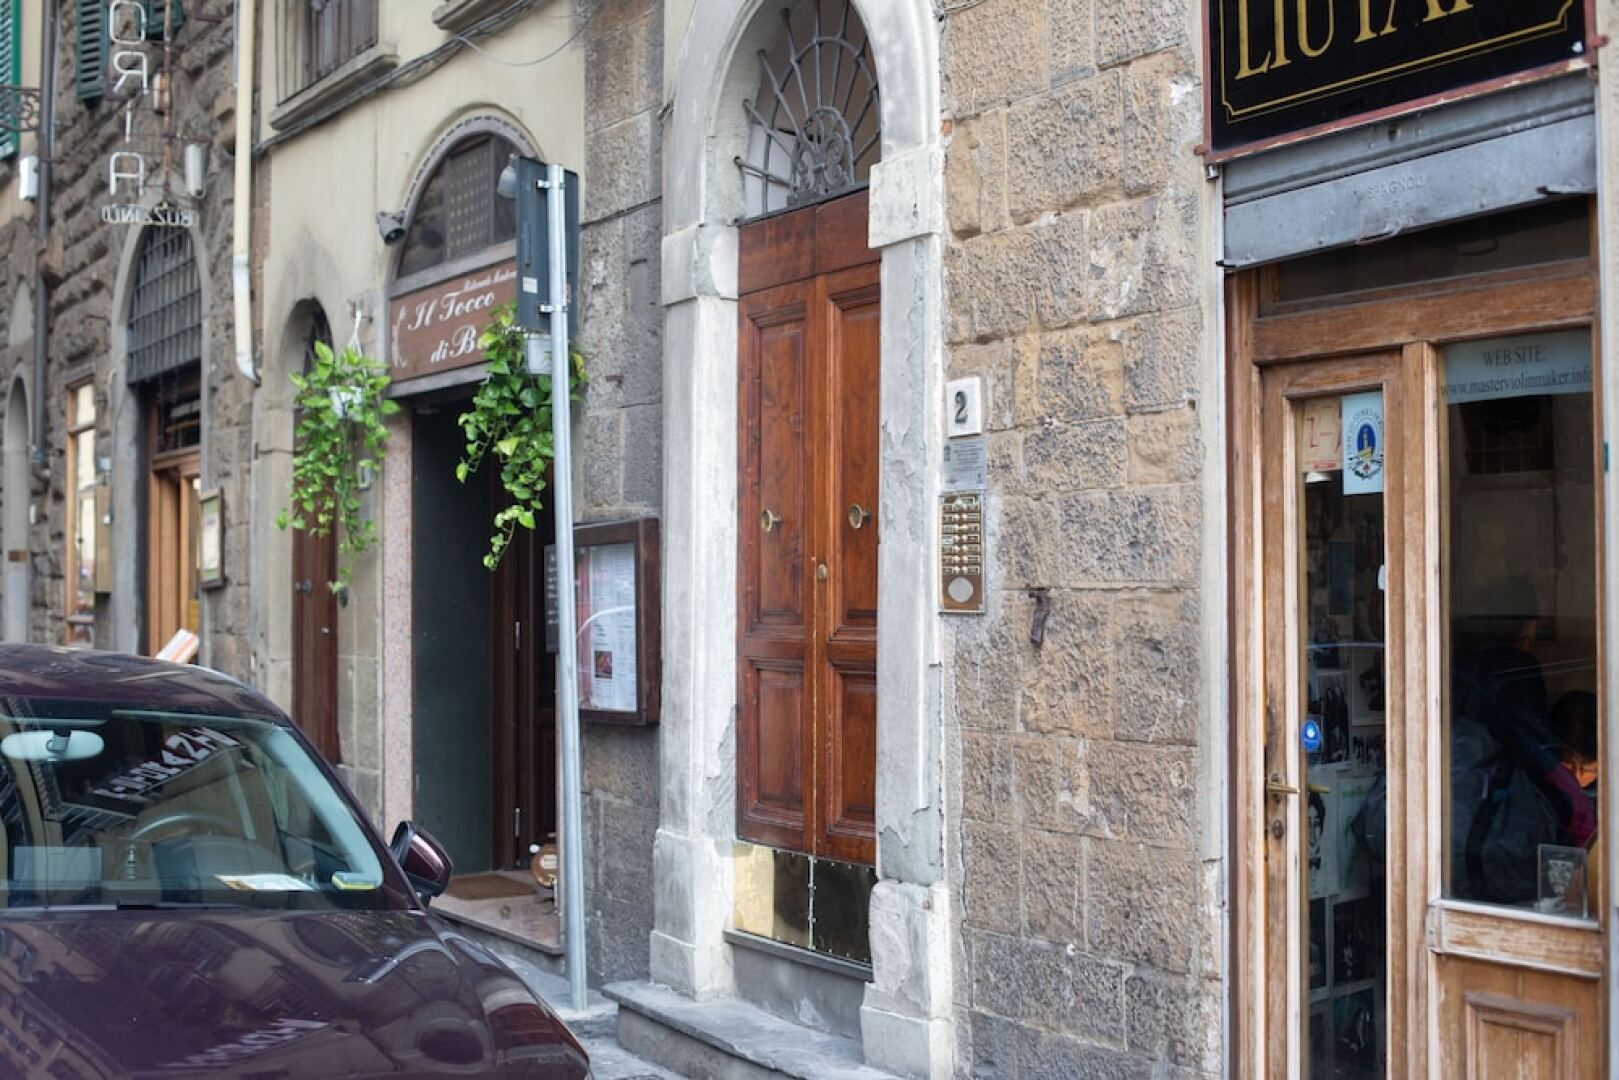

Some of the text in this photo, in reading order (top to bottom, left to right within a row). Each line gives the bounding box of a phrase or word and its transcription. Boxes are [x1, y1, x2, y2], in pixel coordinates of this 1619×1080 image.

[1234, 0, 1474, 79] LIU
[438, 291, 495, 322] Tocco
[430, 339, 450, 364] di
[1482, 349, 1512, 367] WEB
[954, 391, 968, 424] 2
